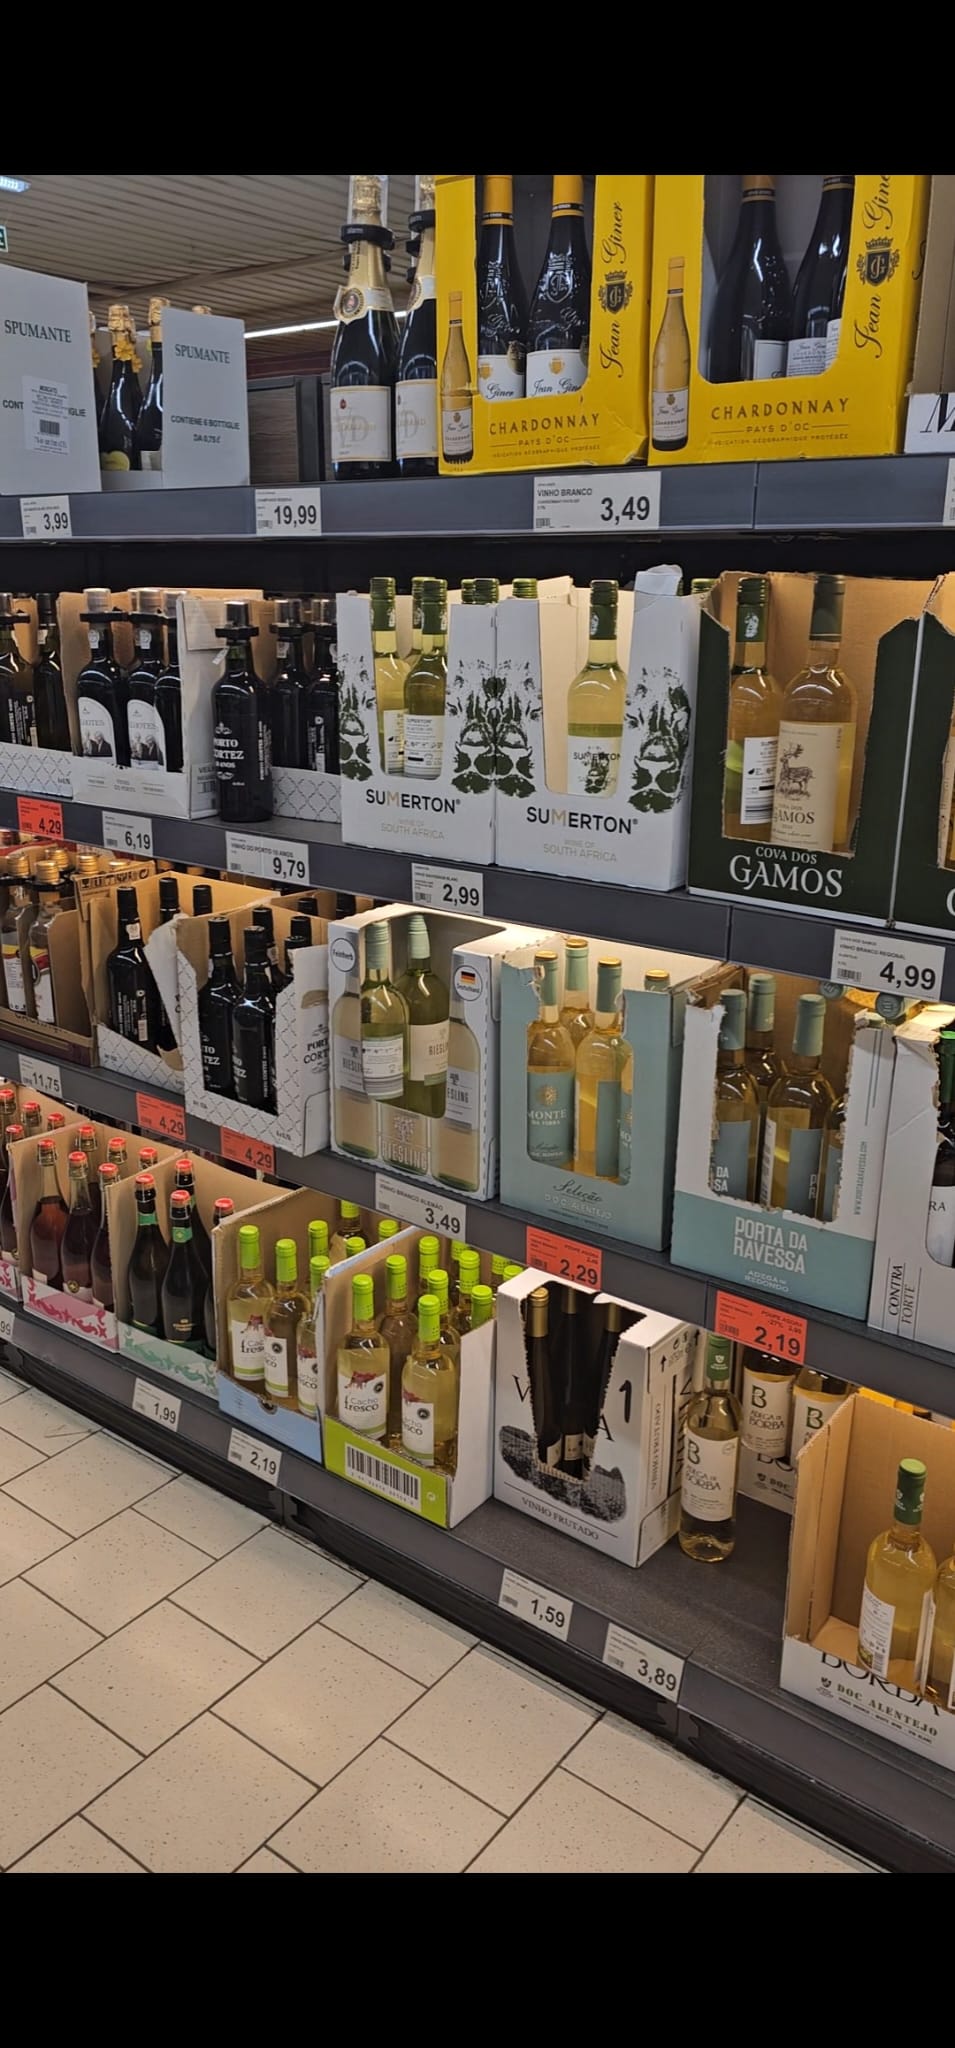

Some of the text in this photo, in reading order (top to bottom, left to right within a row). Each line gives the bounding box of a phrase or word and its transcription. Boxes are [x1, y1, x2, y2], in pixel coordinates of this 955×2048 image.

[854, 175, 893, 358] Jean Gine
[600, 201, 626, 378] Jean Giner
[4, 319, 72, 343] SPUMANTE
[174, 343, 231, 364] SPUMANTE
[486, 382, 514, 400] Giner
[2, 399, 24, 410] CONT
[68, 407, 87, 417] IGLIE
[711, 398, 849, 420] CHARDONNAY
[170, 415, 202, 426] CONTIENE
[489, 413, 600, 435] CHARDONNAY
[746, 424, 775, 433] PAYS
[518, 437, 541, 446] PAYS
[537, 487, 593, 497] VINHO BRANCO
[274, 505, 317, 528] 19,99
[600, 496, 650, 525] 3,49
[43, 512, 69, 533] 3,99
[214, 738, 239, 748] ORTO
[214, 749, 245, 760] ORTEZ
[39, 818, 61, 835] 4,29
[381, 822, 445, 840] SOUTH AFRICA
[125, 831, 151, 850] 6,19
[543, 843, 617, 862] SOUTH AFRICA
[755, 846, 817, 865] COVA DOS
[273, 857, 305, 879] 9,79
[730, 854, 844, 898] GAMOS
[443, 883, 480, 906] 2,99
[880, 961, 936, 990] 4,99
[303, 1049, 329, 1064] CORT
[32, 1072, 60, 1092] 11,75
[447, 1087, 469, 1103] ESLING
[528, 1109, 567, 1120] MONTE
[160, 1116, 184, 1136] 4,29
[245, 1148, 272, 1168] 4,29
[716, 1166, 729, 1178] DA
[396, 1189, 419, 1202] BRANCO
[553, 1179, 602, 1202] Seleção
[425, 1207, 460, 1234] 3,49
[571, 1202, 613, 1220] ALENTEJO
[735, 1216, 808, 1252] PORTA DA
[733, 1237, 806, 1274] RAVESSA
[560, 1259, 598, 1285] 2,29
[748, 1270, 779, 1283] ADEGA
[744, 1275, 789, 1293] REDONDO
[888, 1265, 903, 1316] CONTRA
[901, 1284, 915, 1324] FORTE
[0, 1320, 11, 1336] 99
[754, 1326, 800, 1356] 2,19
[153, 1402, 176, 1425] 1,99
[344, 1395, 379, 1413] fresco
[749, 1416, 785, 1430] BORBA
[250, 1451, 277, 1475] 2,19
[685, 1473, 721, 1491] BORBA
[522, 1497, 599, 1540] VINHO FRUTADO
[531, 1599, 565, 1628] 1,59
[637, 1659, 677, 1691] 3,89
[836, 1683, 938, 1737] DOC ALENTEJO
